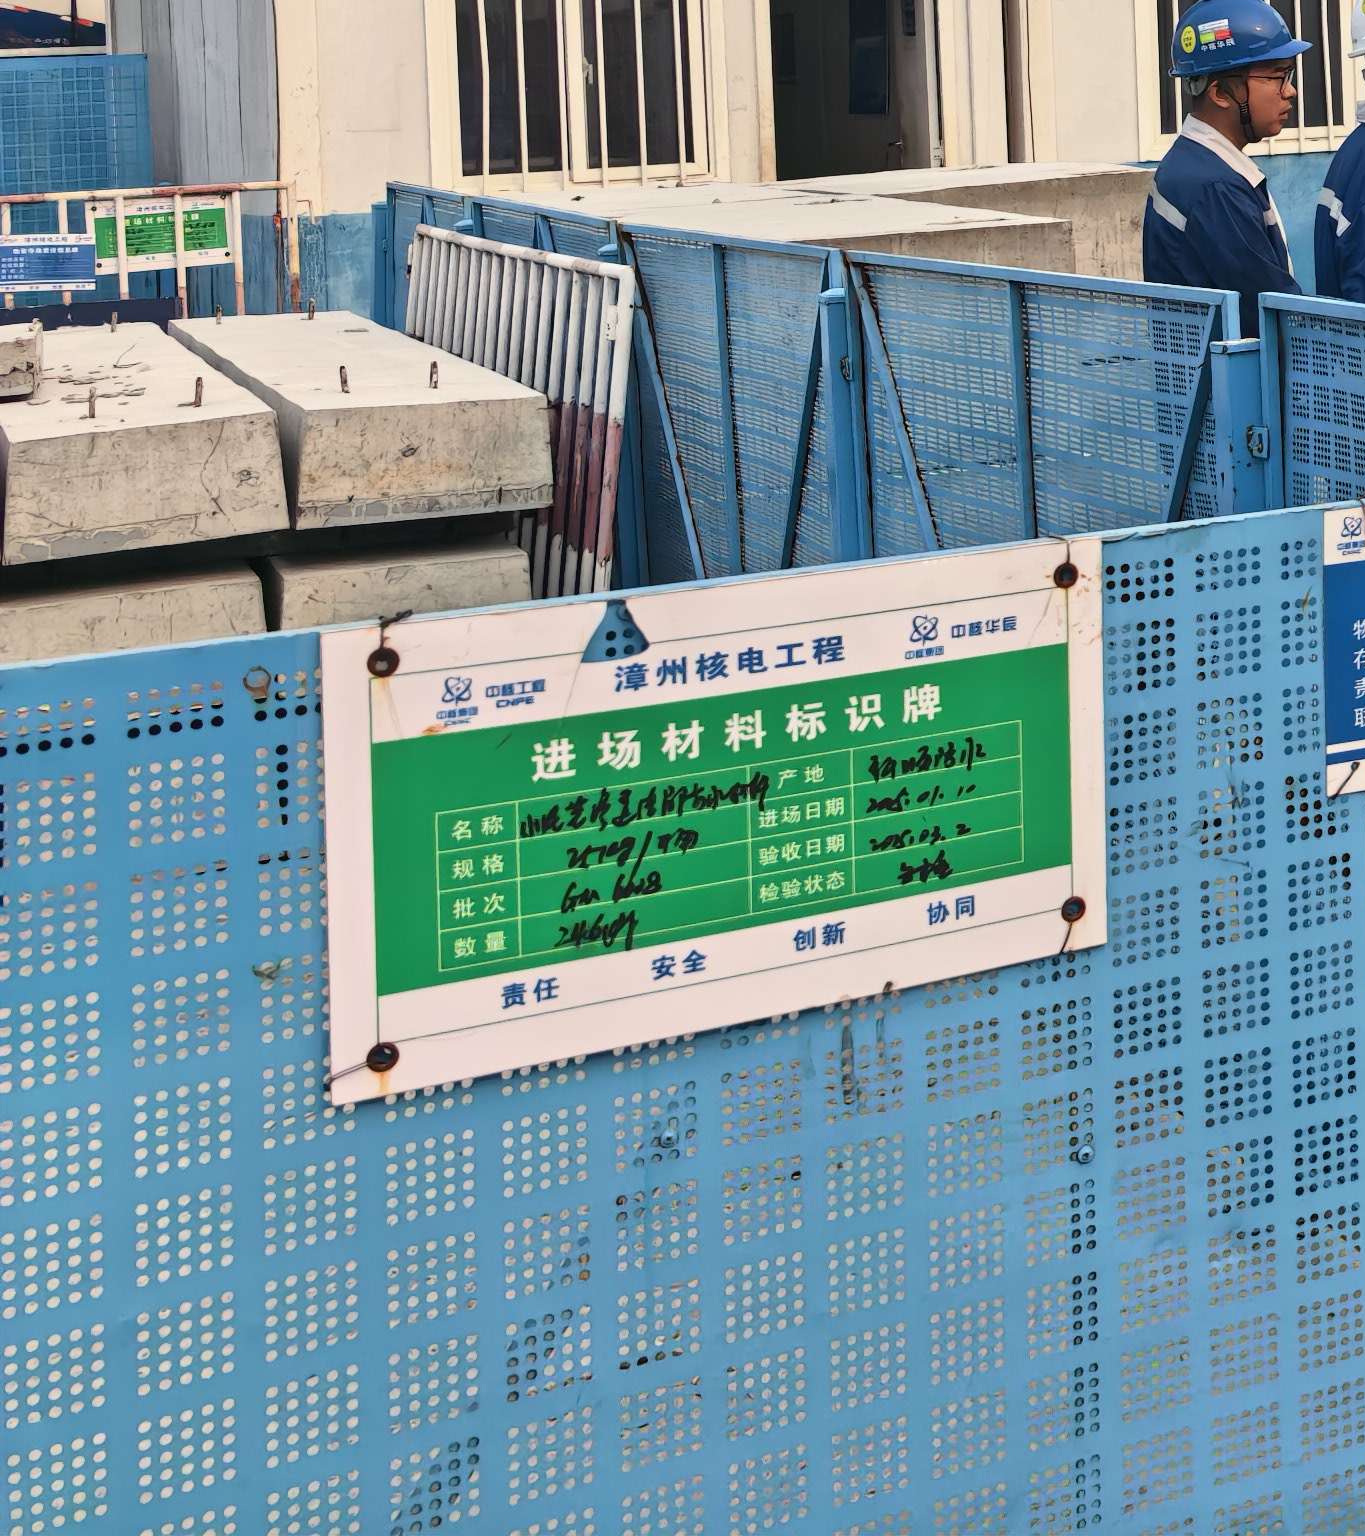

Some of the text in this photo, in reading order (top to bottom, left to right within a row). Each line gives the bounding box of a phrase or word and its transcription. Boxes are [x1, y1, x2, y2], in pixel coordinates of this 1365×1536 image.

[614, 635, 845, 693] 漳州核电工程
[531, 683, 942, 784] 进场材料标识牌
[777, 764, 825, 789] 产地
[452, 815, 505, 842] 名称
[758, 797, 845, 829] 进场日期
[759, 834, 845, 866] 验收日期
[452, 853, 505, 880] 规格
[760, 871, 846, 903] 检验状态
[452, 892, 506, 920] 批次
[454, 930, 507, 958] 数量
[501, 895, 976, 1009] 责任 安全 创新 协同
